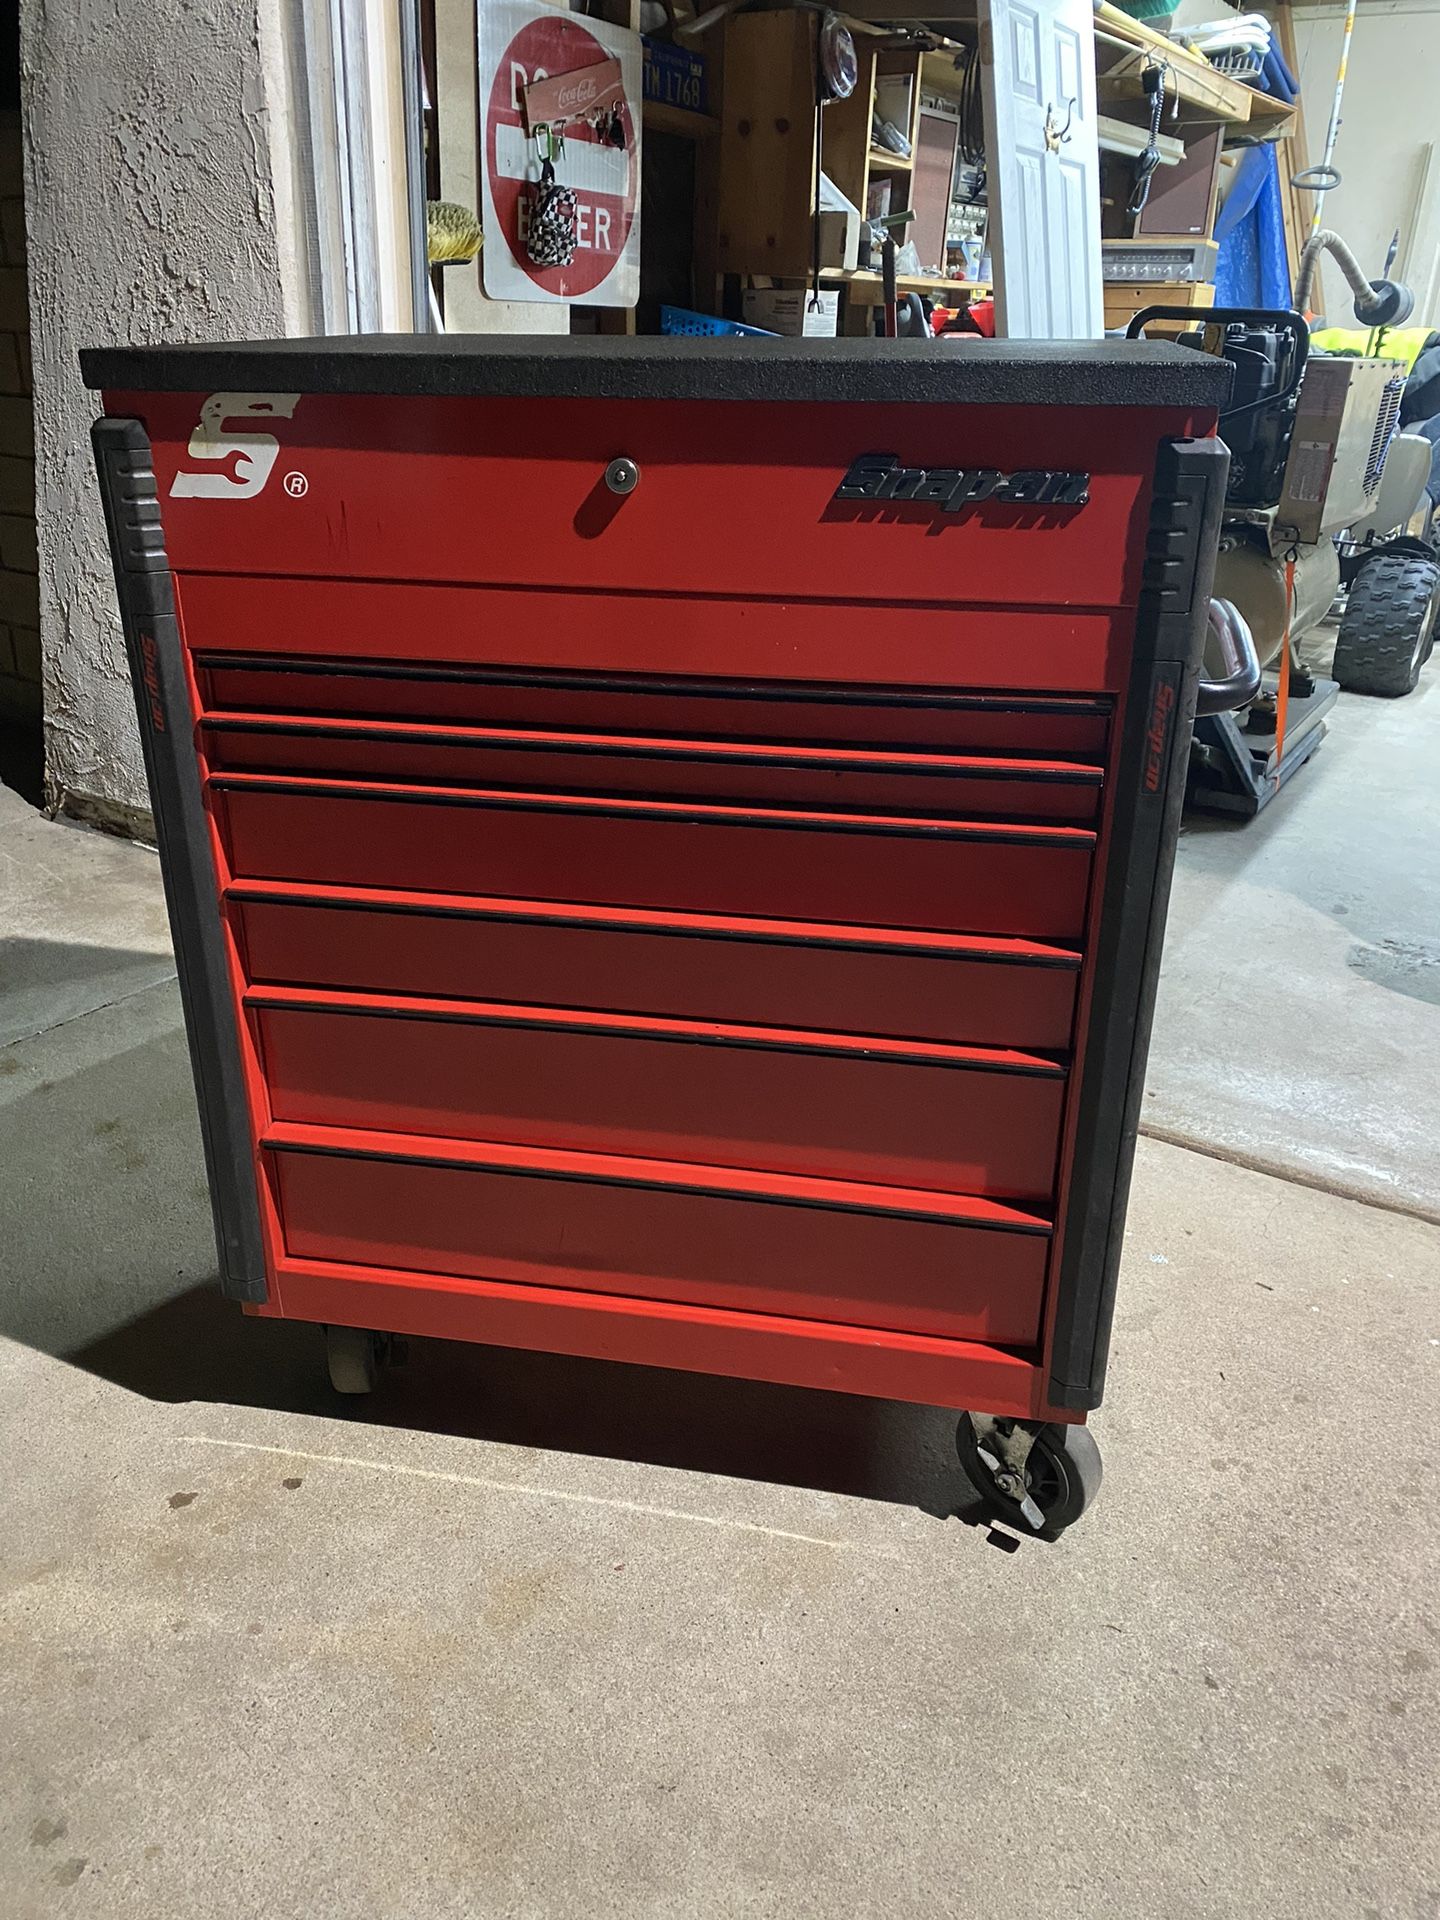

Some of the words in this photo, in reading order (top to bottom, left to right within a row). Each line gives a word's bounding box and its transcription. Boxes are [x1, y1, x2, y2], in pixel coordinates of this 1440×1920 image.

[666, 70, 700, 108] 1768
[518, 196, 611, 250] EER
[836, 453, 1091, 512] Snap-on
[140, 633, 165, 732] Snap-on
[1146, 682, 1173, 792] Snap-on
